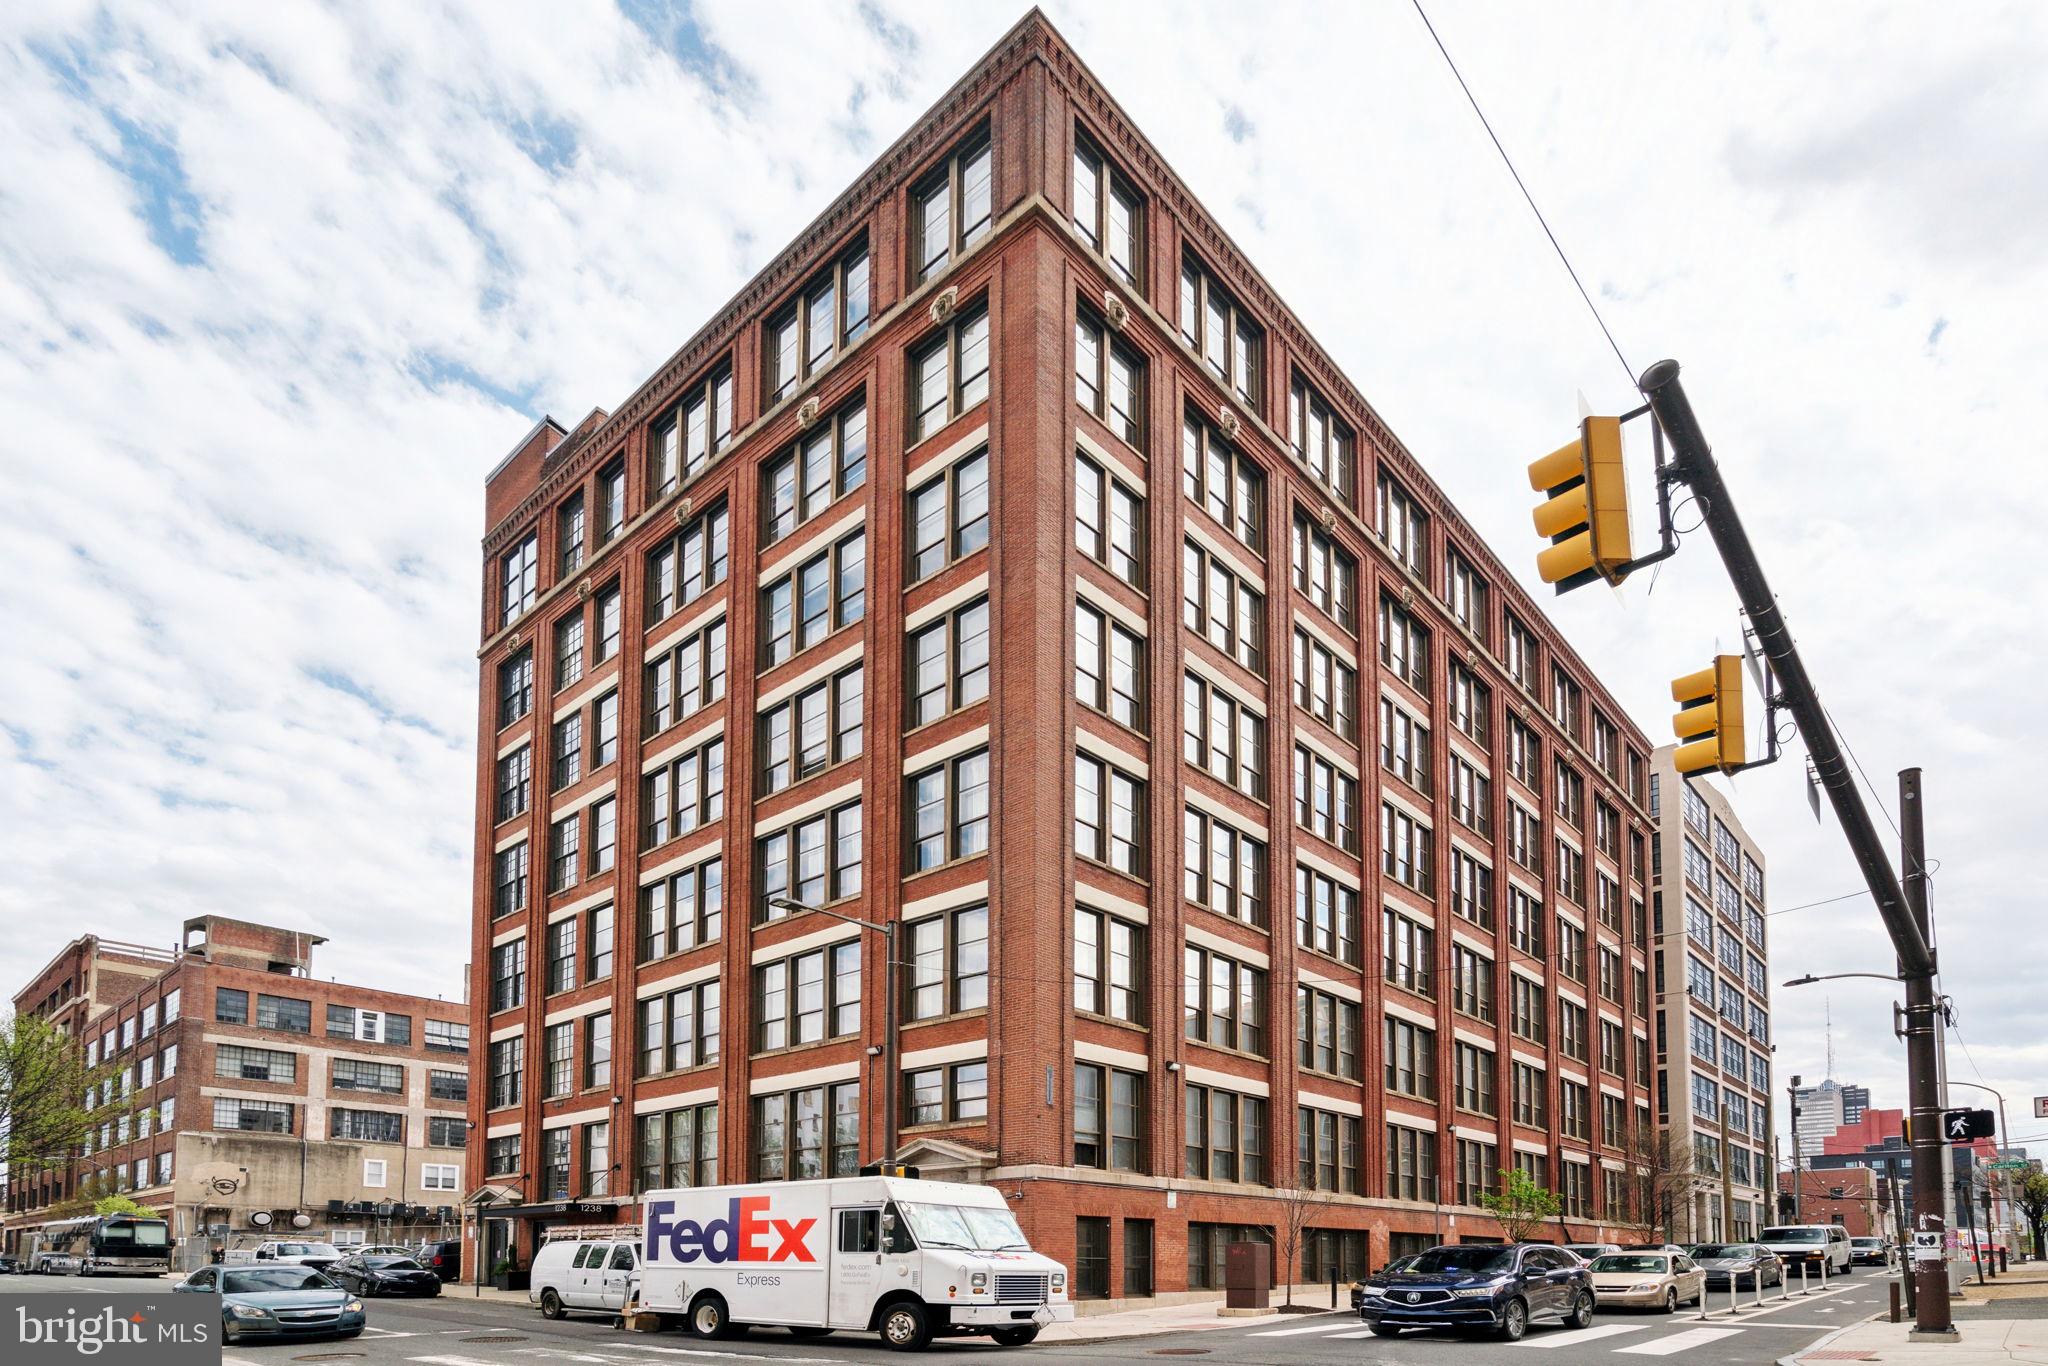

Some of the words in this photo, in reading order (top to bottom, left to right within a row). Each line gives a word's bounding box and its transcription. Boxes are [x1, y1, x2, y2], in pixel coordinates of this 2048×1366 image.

[580, 1204, 602, 1213] 1238
[646, 1195, 818, 1264] FedEx
[737, 1272, 781, 1288] Express
